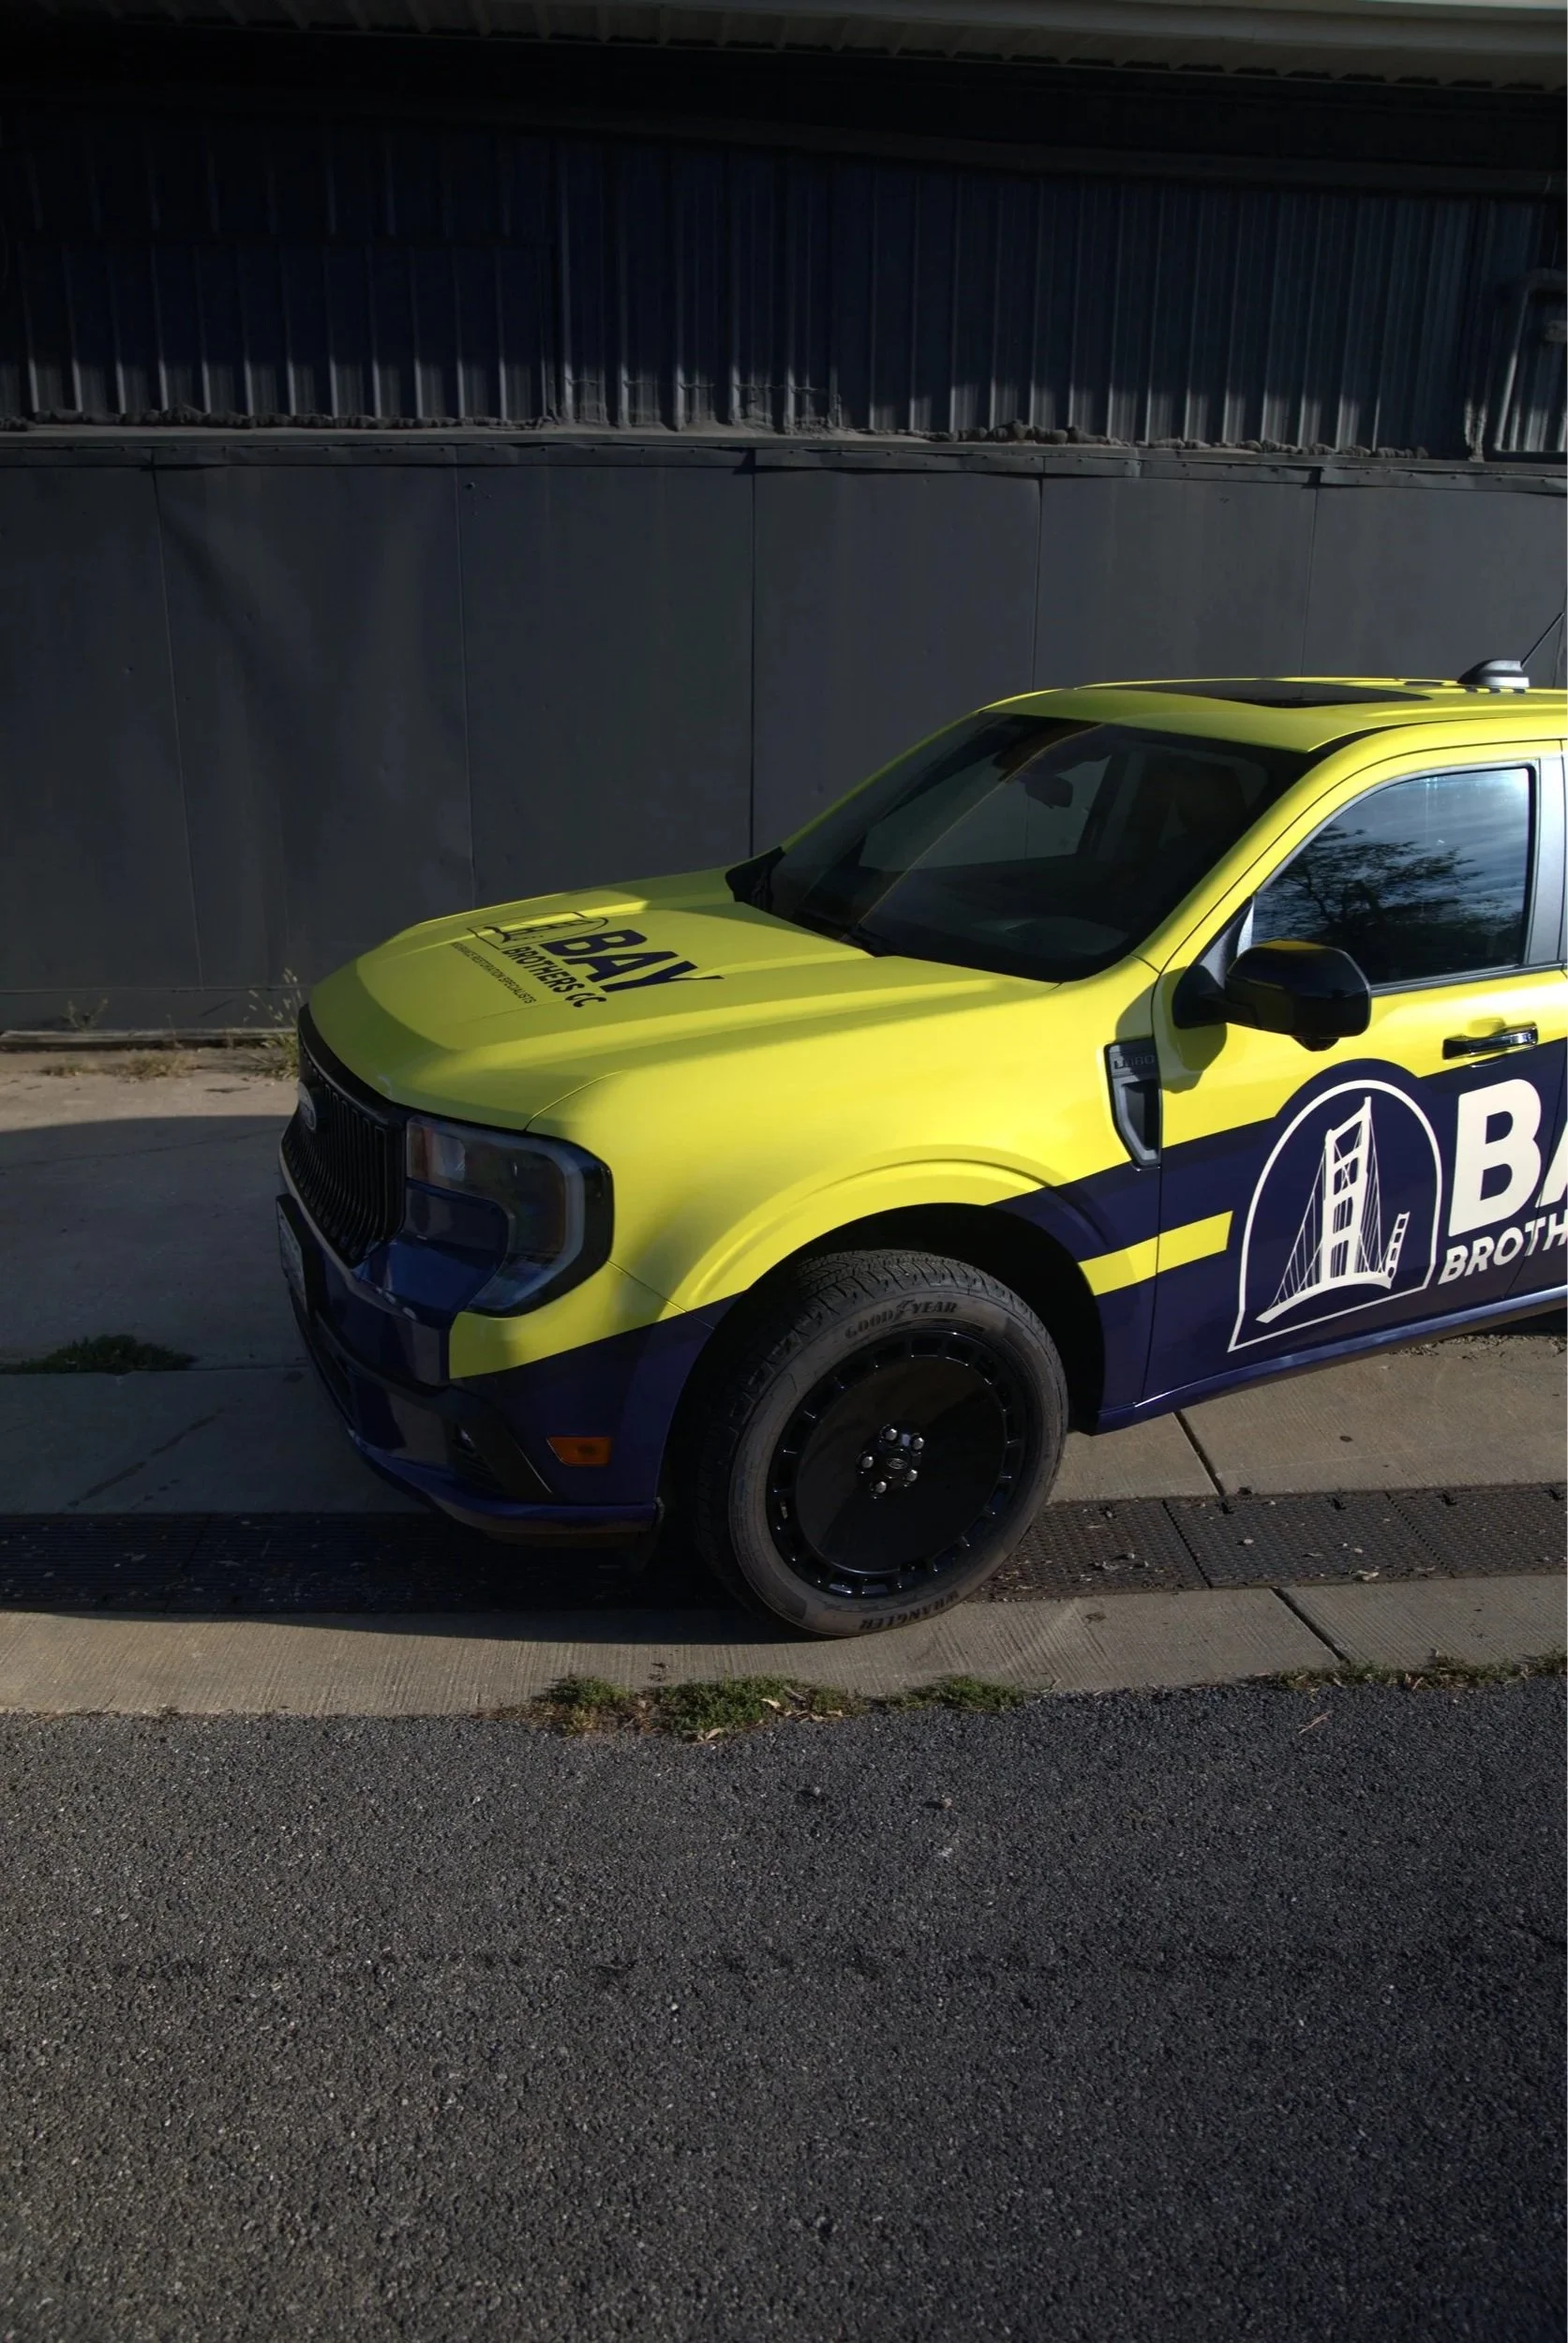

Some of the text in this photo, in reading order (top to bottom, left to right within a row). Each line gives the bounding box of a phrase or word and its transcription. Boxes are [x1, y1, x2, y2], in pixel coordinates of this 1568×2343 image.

[502, 947, 585, 993] BROTHERS
[540, 930, 724, 992] BAY
[499, 977, 537, 1005] SPECIALISTS
[844, 1300, 958, 1338] GOODYEAR
